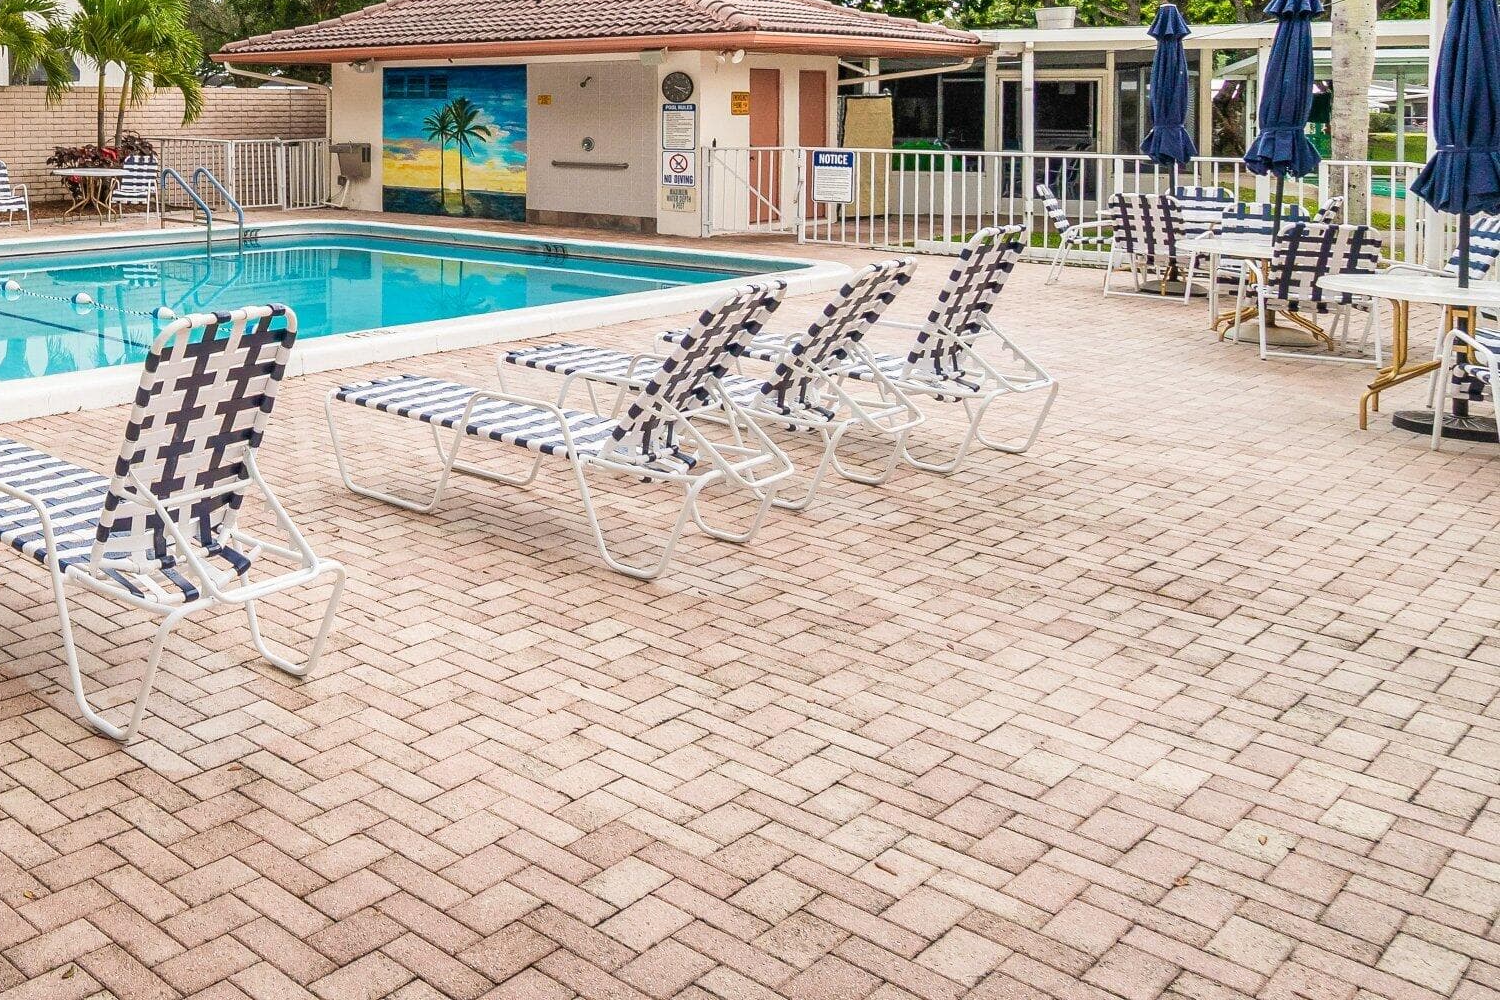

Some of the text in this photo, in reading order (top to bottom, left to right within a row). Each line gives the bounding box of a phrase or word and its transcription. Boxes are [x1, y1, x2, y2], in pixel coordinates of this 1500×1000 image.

[819, 154, 848, 165] NOTICE
[664, 175, 693, 184] NO DIVING
